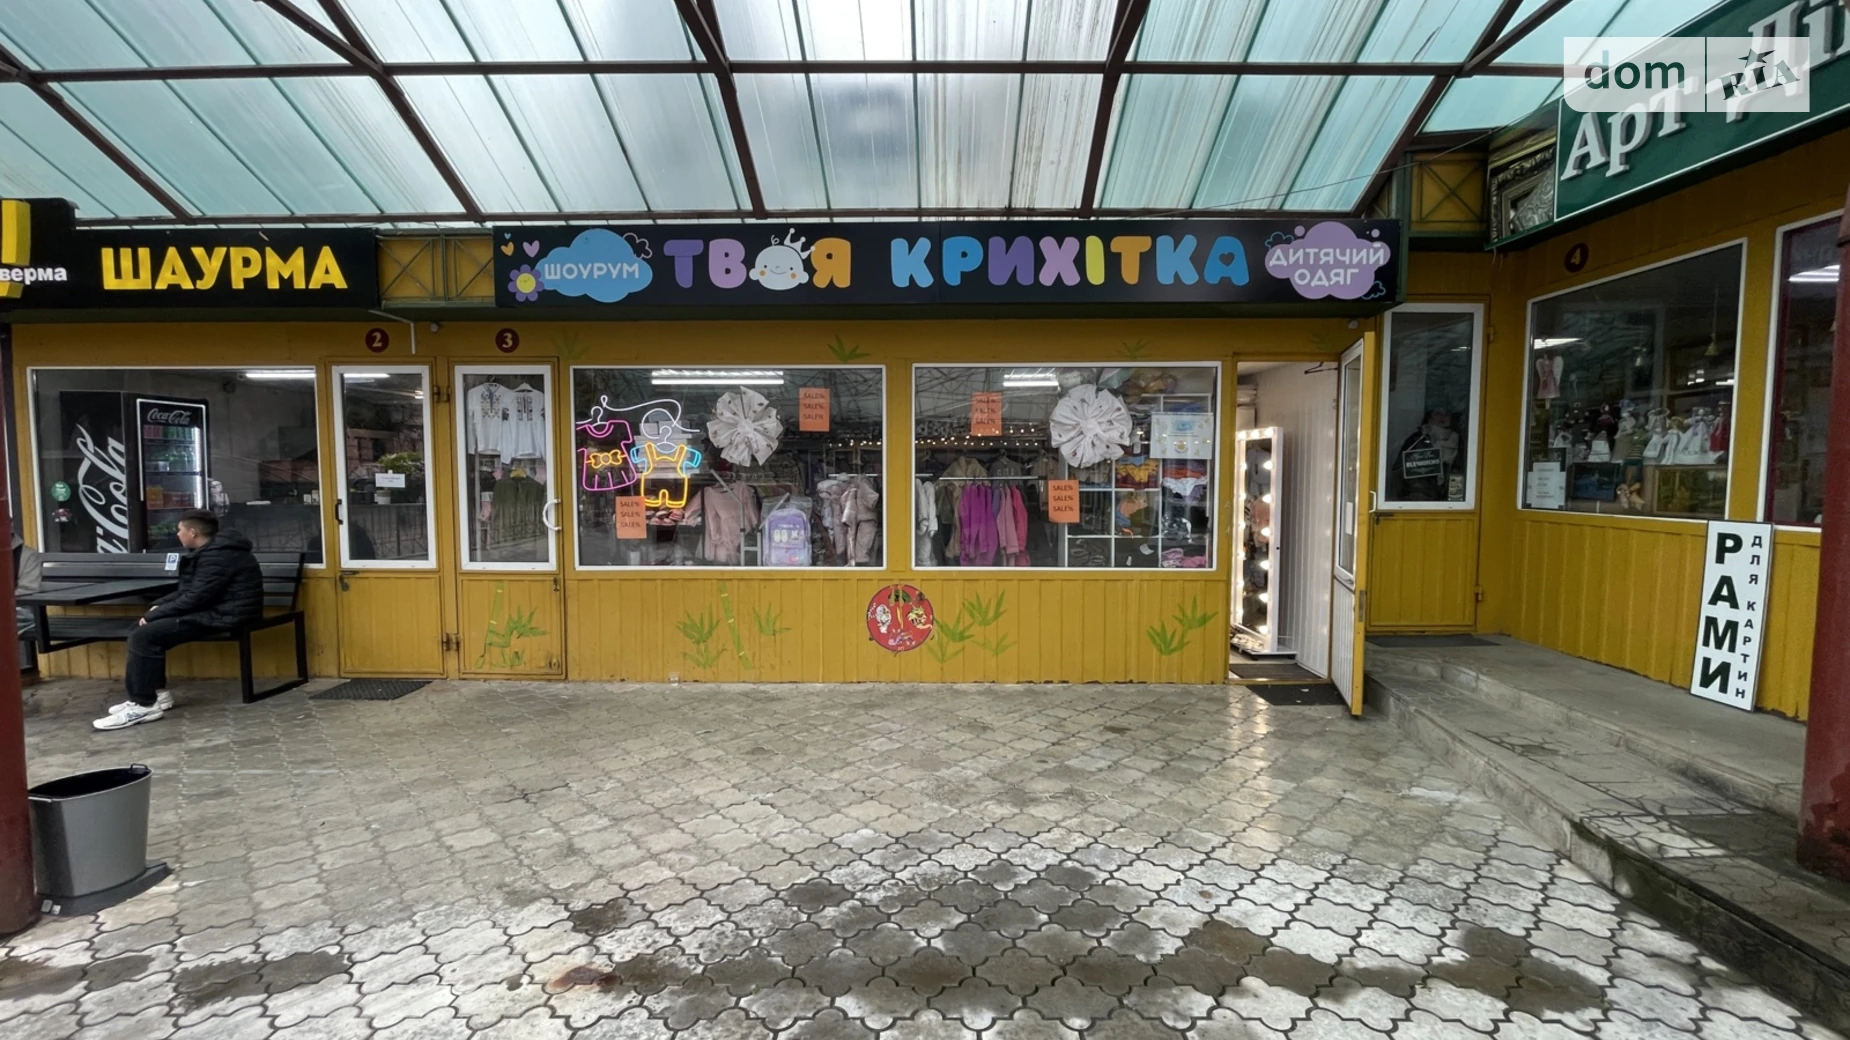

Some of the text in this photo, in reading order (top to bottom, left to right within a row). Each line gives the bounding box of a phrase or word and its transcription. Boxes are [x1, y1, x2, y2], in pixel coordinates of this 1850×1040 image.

[890, 234, 1250, 288] КРИХІТКА
[1269, 242, 1385, 267] ДИТЯЧИЙ
[1570, 248, 1581, 265] 4
[100, 246, 348, 291] ШАУРМА
[544, 263, 639, 279] ШОУРУМ
[1294, 268, 1360, 287] ОДЯГ
[372, 332, 383, 347] 2
[502, 332, 513, 348] 3
[1699, 532, 1743, 694] РАМИ
[1735, 535, 1763, 699] ДЛЯ КАРТИН
